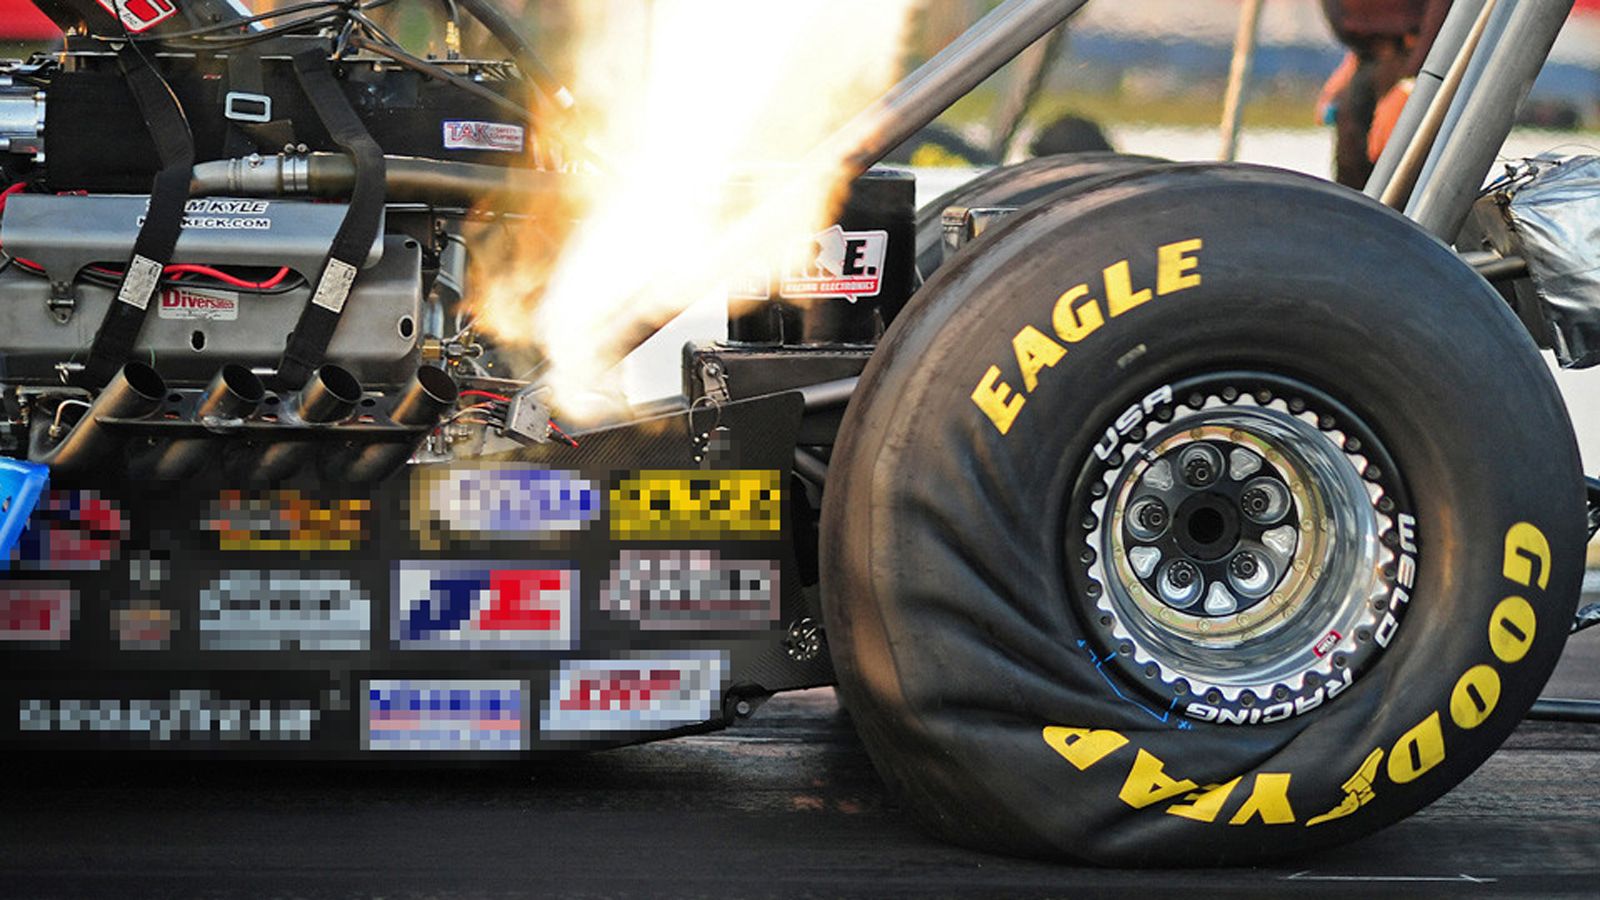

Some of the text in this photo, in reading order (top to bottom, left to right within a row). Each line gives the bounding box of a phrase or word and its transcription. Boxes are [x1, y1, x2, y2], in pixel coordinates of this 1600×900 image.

[210, 201, 269, 214] KYLE
[971, 238, 1204, 436] EAGLE
[1093, 384, 1172, 461] USA
[1184, 512, 1418, 724] WELD RACING
